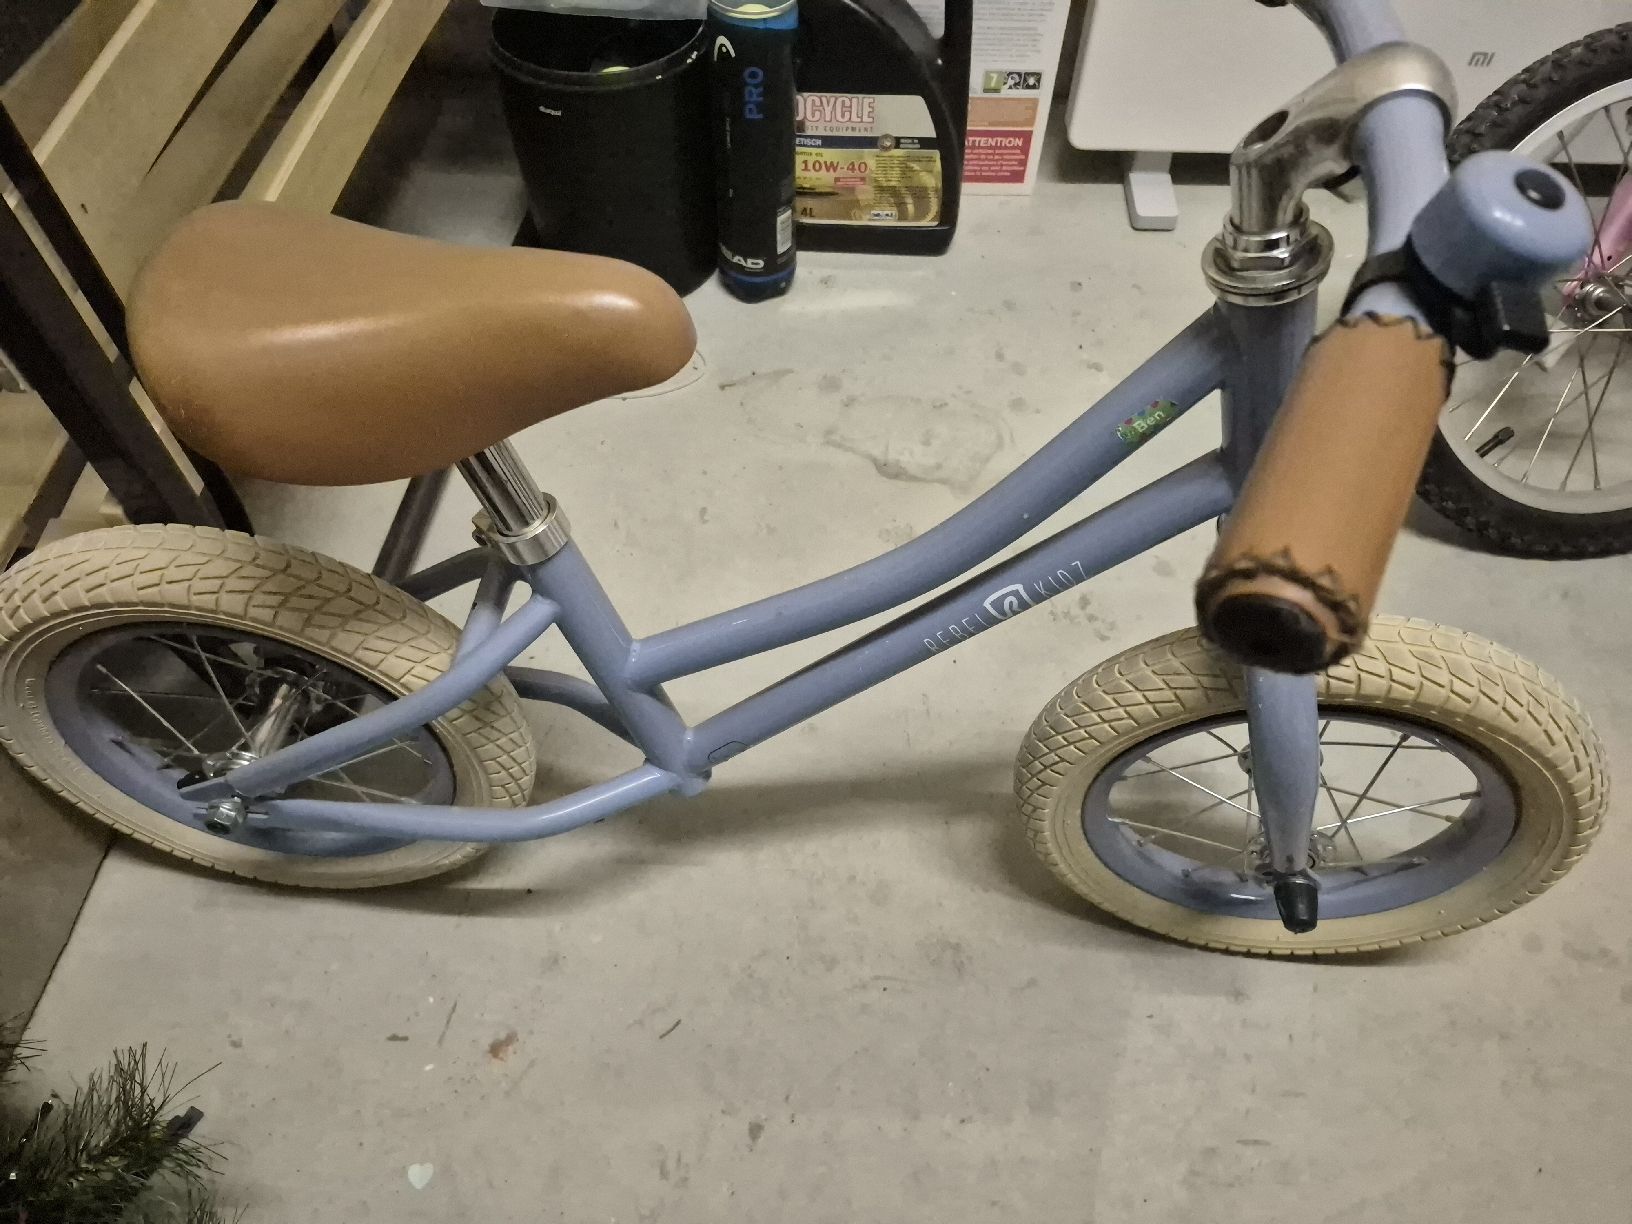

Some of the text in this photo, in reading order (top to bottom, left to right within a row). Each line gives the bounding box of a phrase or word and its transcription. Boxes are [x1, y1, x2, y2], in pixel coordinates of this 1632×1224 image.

[743, 66, 764, 119] PRO
[801, 160, 868, 174] 10W-40
[801, 207, 815, 218] 4L
